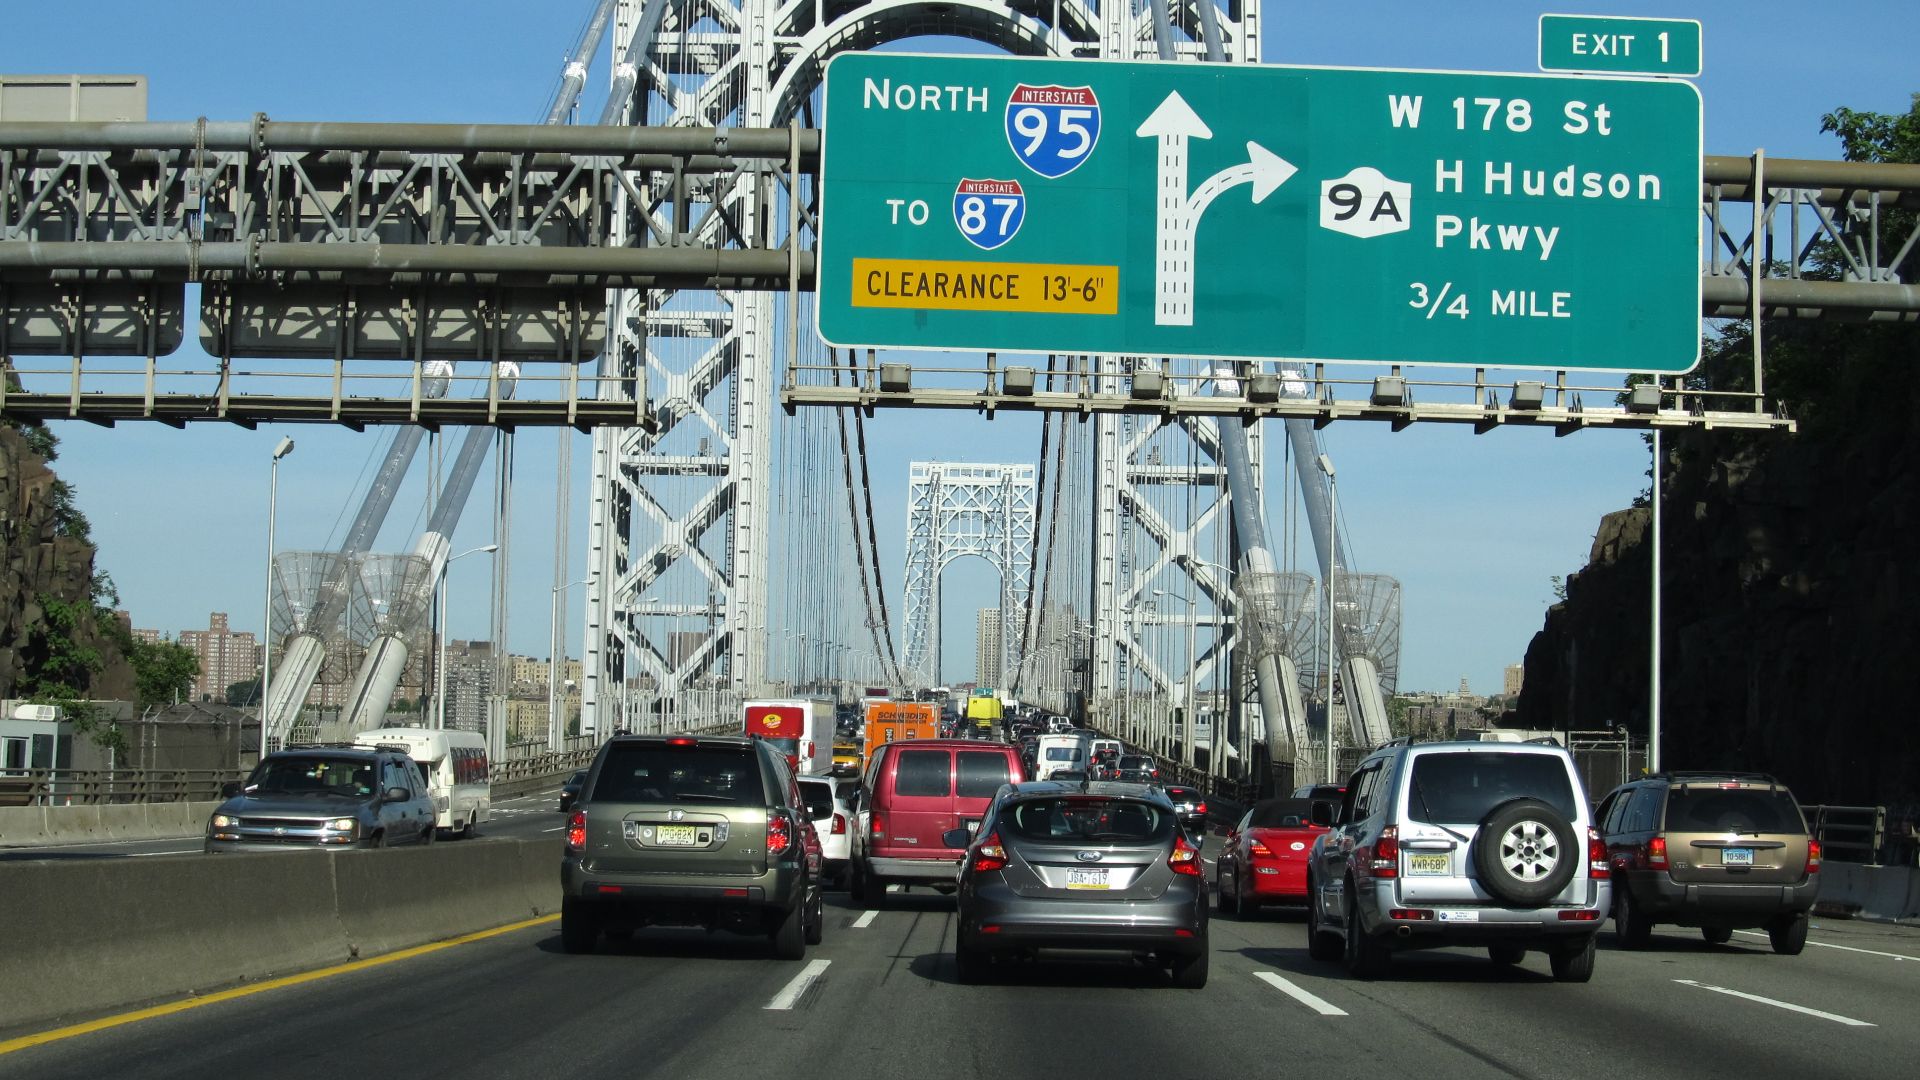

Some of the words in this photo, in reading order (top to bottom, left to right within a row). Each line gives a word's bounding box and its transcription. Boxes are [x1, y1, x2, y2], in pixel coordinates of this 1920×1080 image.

[1572, 33, 1635, 57] EXIT
[1657, 32, 1670, 63] 1
[863, 77, 989, 114] NORTH
[1021, 89, 1086, 104] INTERSTATE
[1014, 107, 1093, 159] 95
[1388, 94, 1423, 129] W
[1452, 97, 1533, 133] 178
[1562, 100, 1612, 136] St
[965, 182, 1015, 195] INTERSTATE
[1435, 159, 1463, 194] H
[1484, 161, 1661, 201] Hudson
[886, 198, 930, 226] TO
[959, 196, 1019, 236] 87
[1328, 183, 1403, 223] 9A
[1435, 214, 1560, 261] Pkwy
[867, 269, 1020, 301] CLEARANCE
[1041, 274, 1104, 303] 13'-6"
[1408, 282, 1470, 320] 3/4
[1491, 290, 1572, 318] MILE
